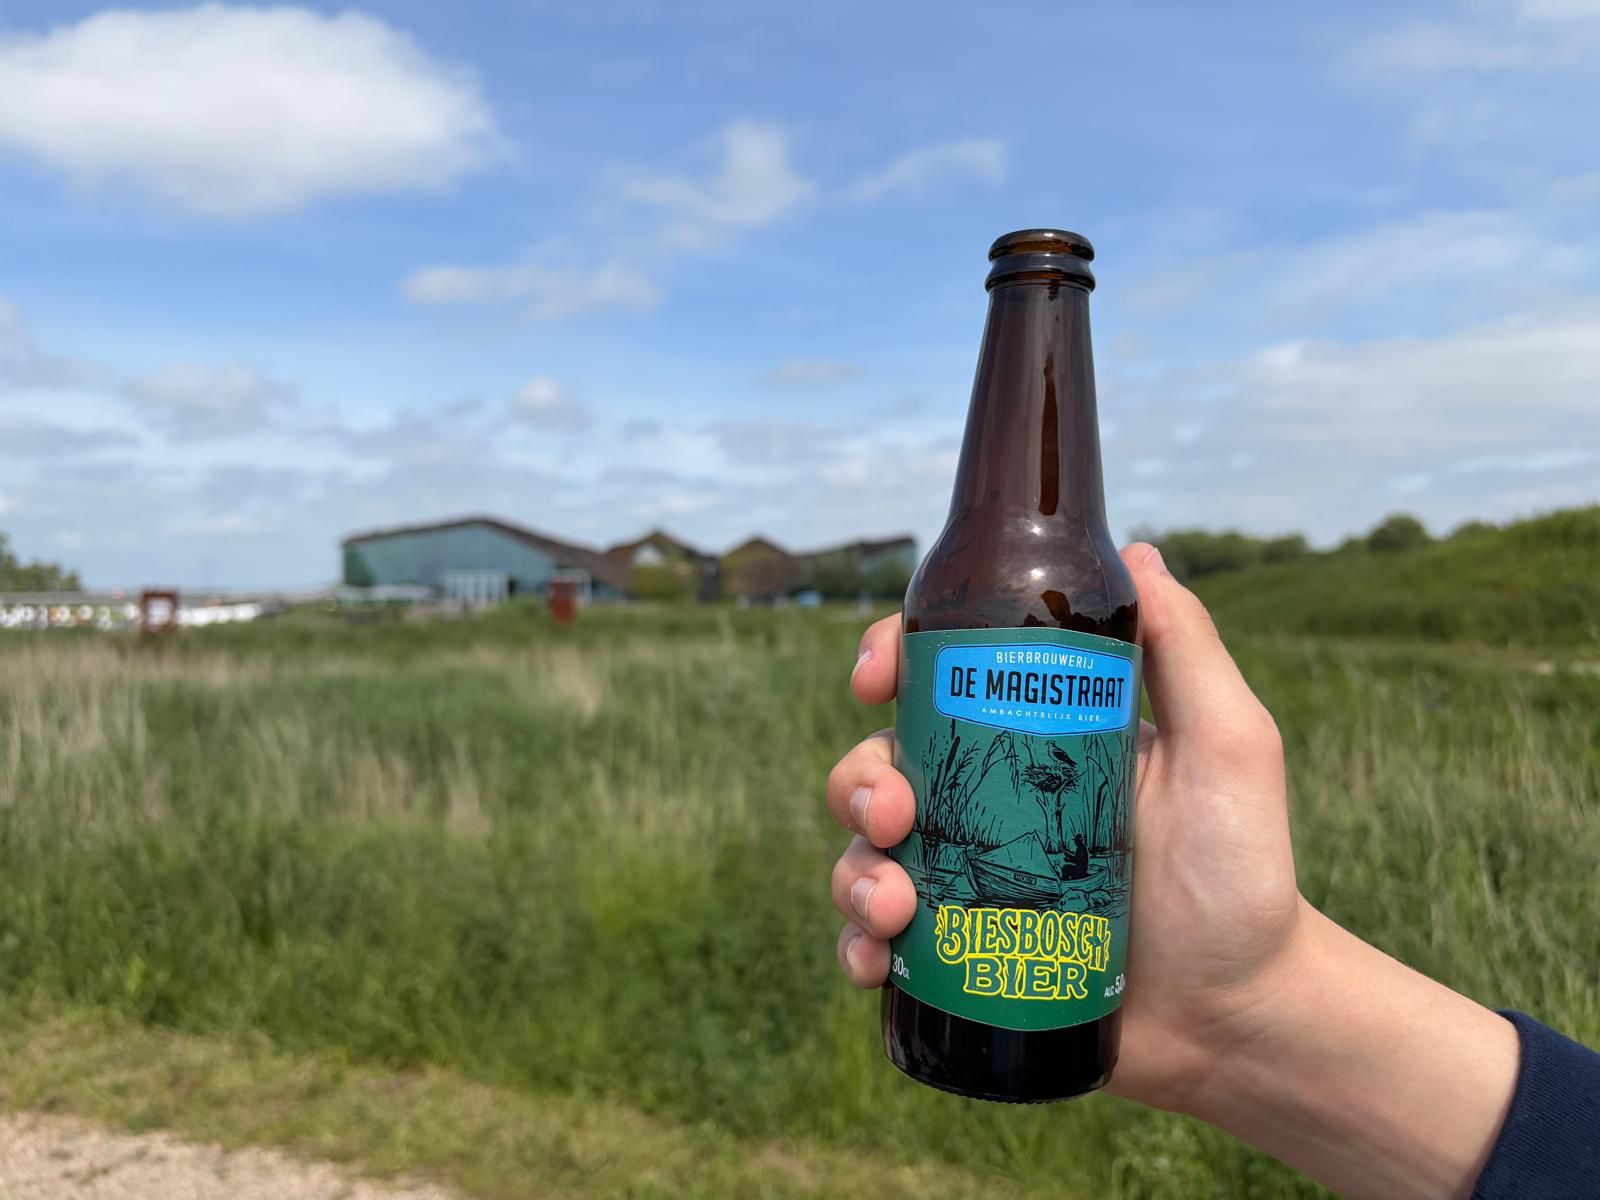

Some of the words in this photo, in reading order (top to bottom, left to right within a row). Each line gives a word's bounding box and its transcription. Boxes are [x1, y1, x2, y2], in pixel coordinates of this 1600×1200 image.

[996, 651, 1094, 670] BIERBROUWERIJ
[950, 666, 977, 699] DE
[985, 669, 1125, 708] MAGISTRAAT
[981, 707, 1072, 720] AMBACHTELIJK
[1078, 714, 1100, 722] BIER
[935, 905, 1111, 972] BIESBOSCH
[963, 956, 1088, 1000] BIER
